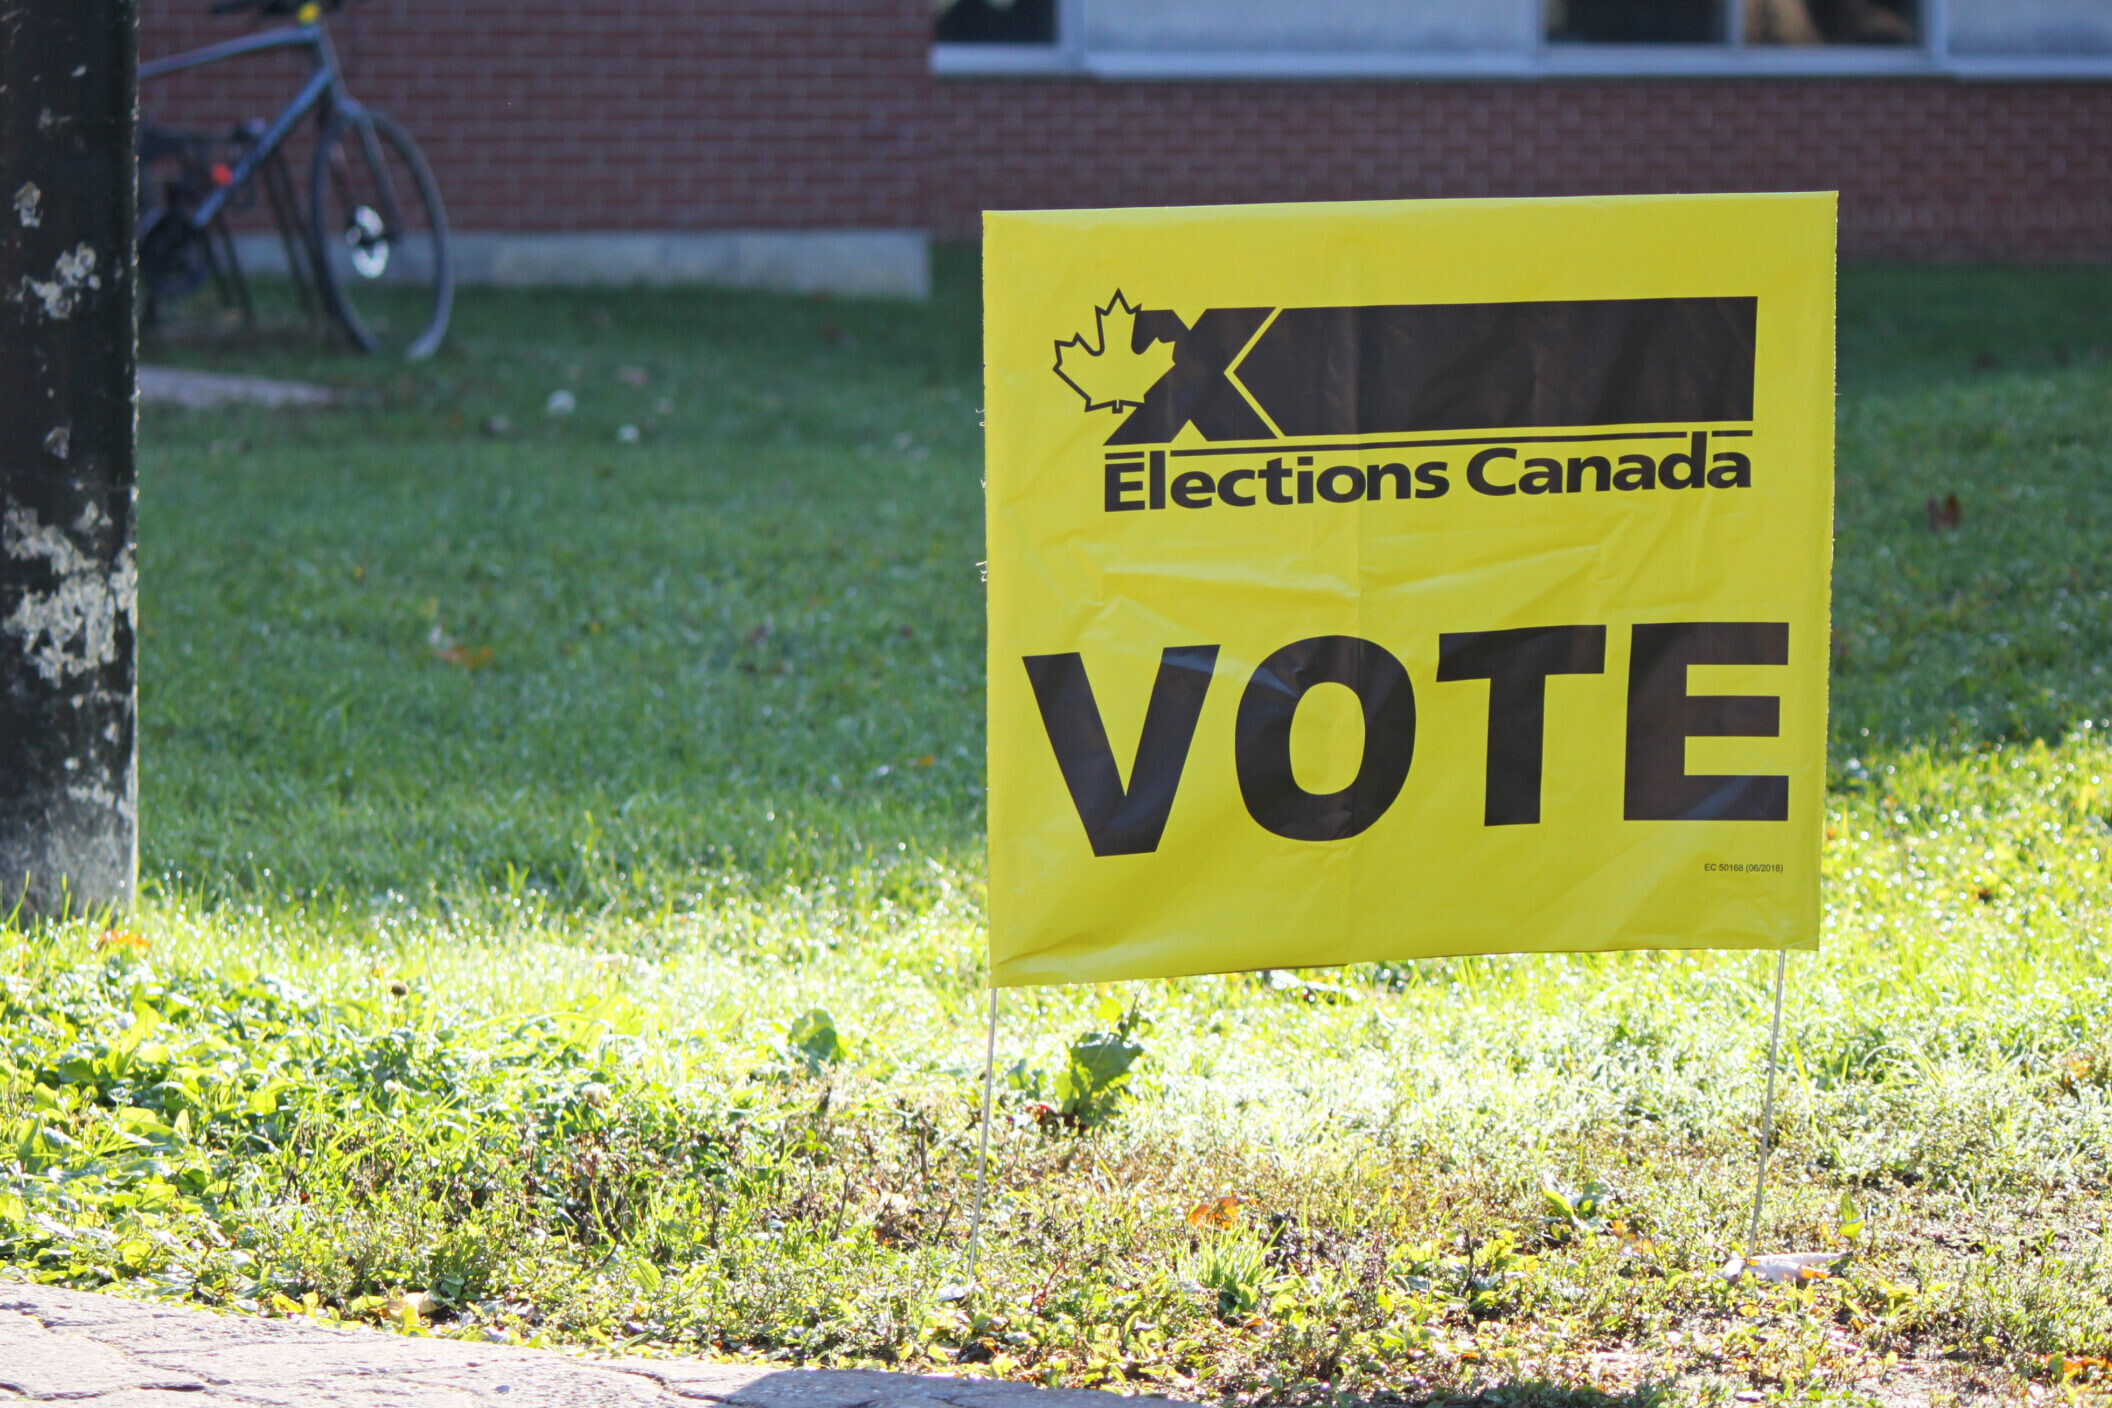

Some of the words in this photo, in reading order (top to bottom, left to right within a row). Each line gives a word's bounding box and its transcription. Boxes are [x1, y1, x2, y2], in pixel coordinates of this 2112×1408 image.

[1104, 450, 1449, 513] Elections
[1465, 432, 1751, 497] Canada
[1023, 622, 1789, 857] VOTE
[1704, 863, 1717, 872] EC
